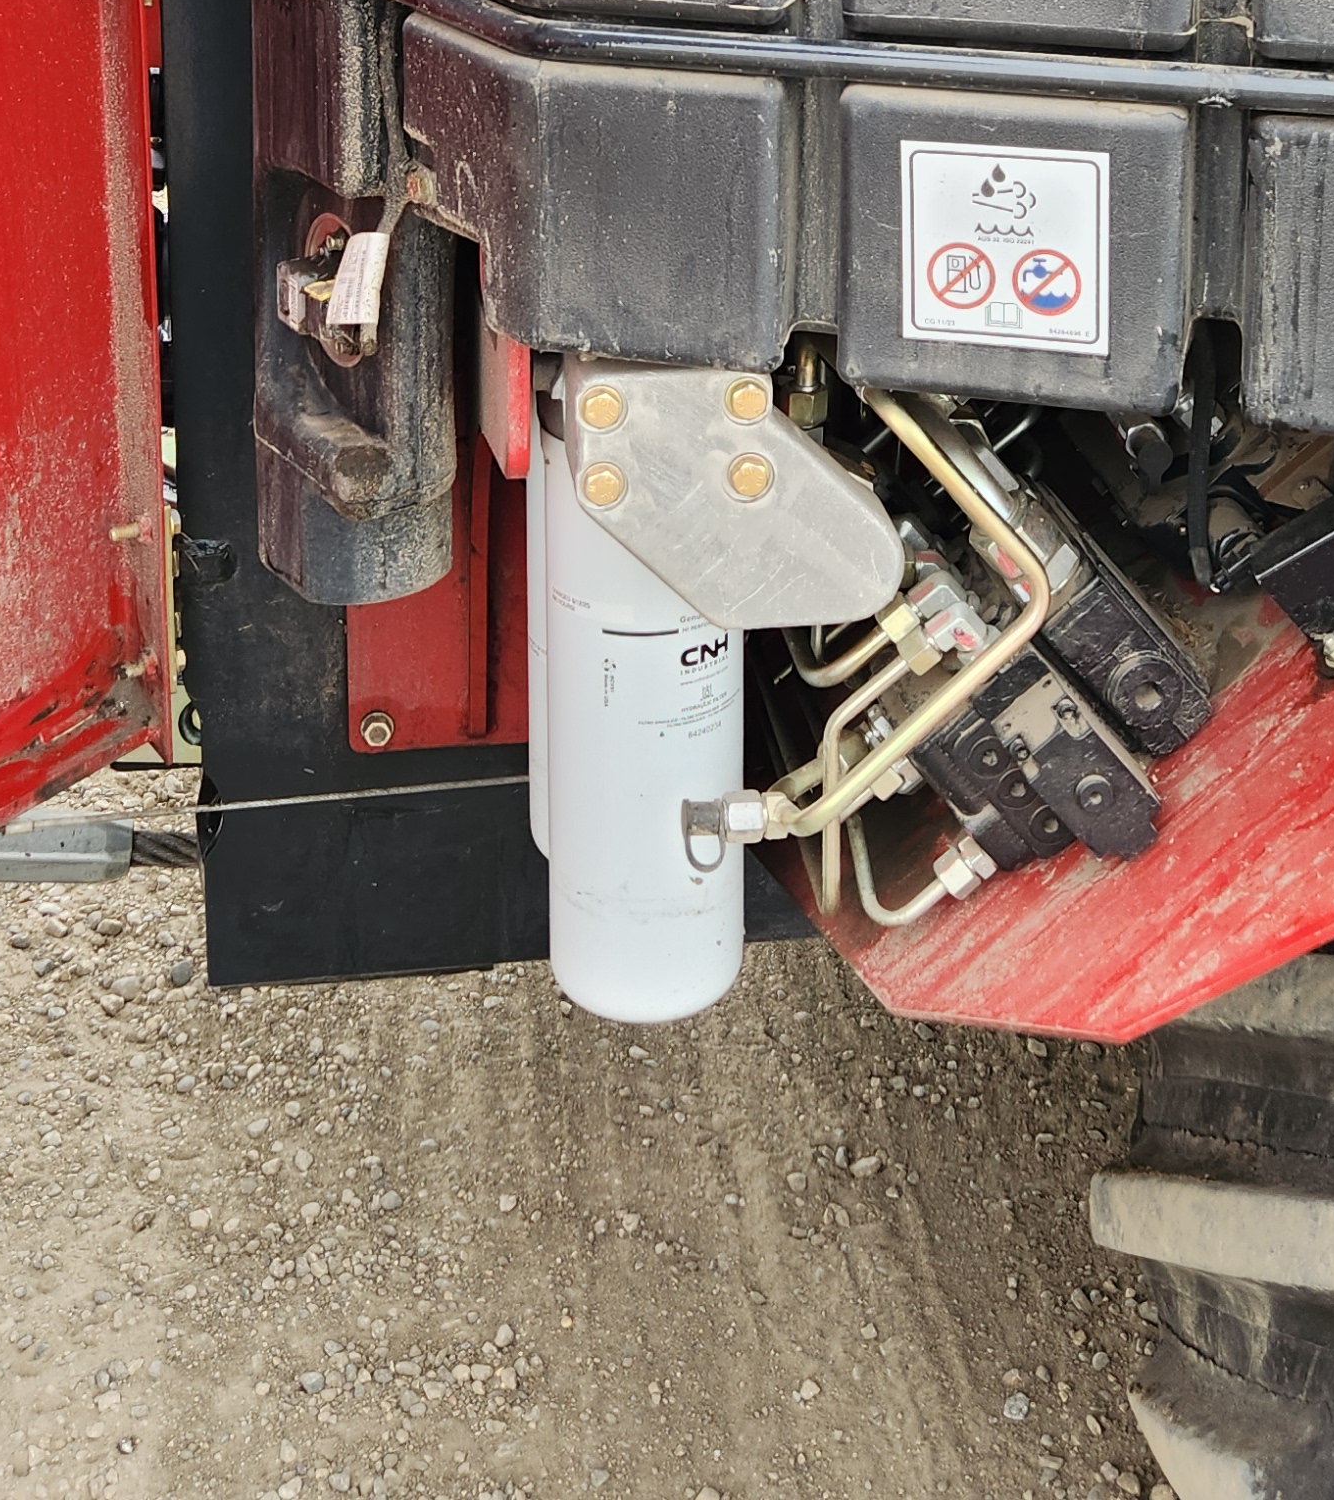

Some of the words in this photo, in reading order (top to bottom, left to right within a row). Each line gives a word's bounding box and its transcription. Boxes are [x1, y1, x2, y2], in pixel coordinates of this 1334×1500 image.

[679, 614, 701, 624] Genu
[680, 631, 729, 668] CNH
[680, 653, 729, 676] INDUSTRIAL
